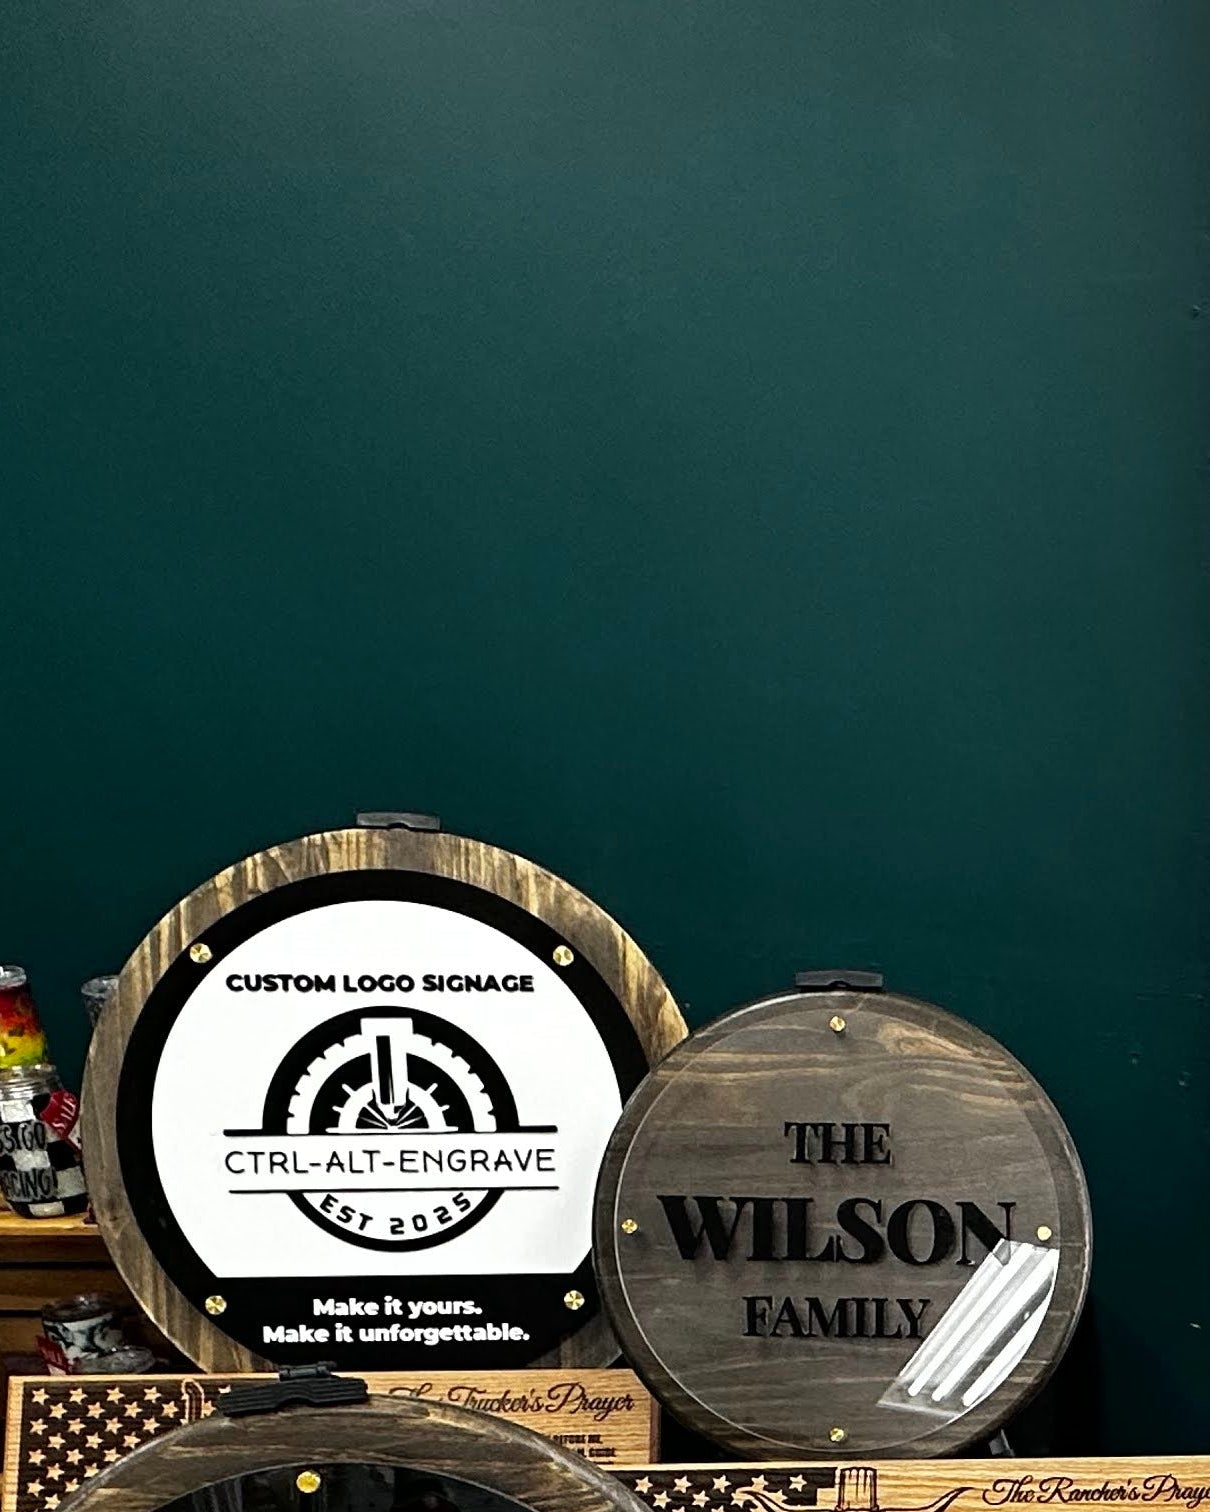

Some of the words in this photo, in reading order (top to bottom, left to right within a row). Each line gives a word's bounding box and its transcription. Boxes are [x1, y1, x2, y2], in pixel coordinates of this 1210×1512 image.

[225, 973, 336, 993] CUSTOM
[342, 974, 413, 993] LOGO
[422, 974, 534, 993] SIGNAGE
[784, 1121, 891, 1164] THE
[225, 1147, 557, 1176] CTRL-ALT-ENGRAVE
[318, 1192, 374, 1232] EST
[389, 1191, 472, 1236] 2025
[658, 1194, 1016, 1266] WILSON
[312, 1297, 381, 1316] Make
[385, 1296, 402, 1315] it
[406, 1299, 483, 1321] yours.
[743, 1296, 931, 1338] FAMILY
[263, 1324, 331, 1343] Make
[335, 1323, 353, 1343] it
[358, 1323, 530, 1345] unforgettable.
[546, 1382, 635, 1421] Prayer
[982, 1475, 1035, 1506] The
[1037, 1476, 1140, 1504] Rancher's
